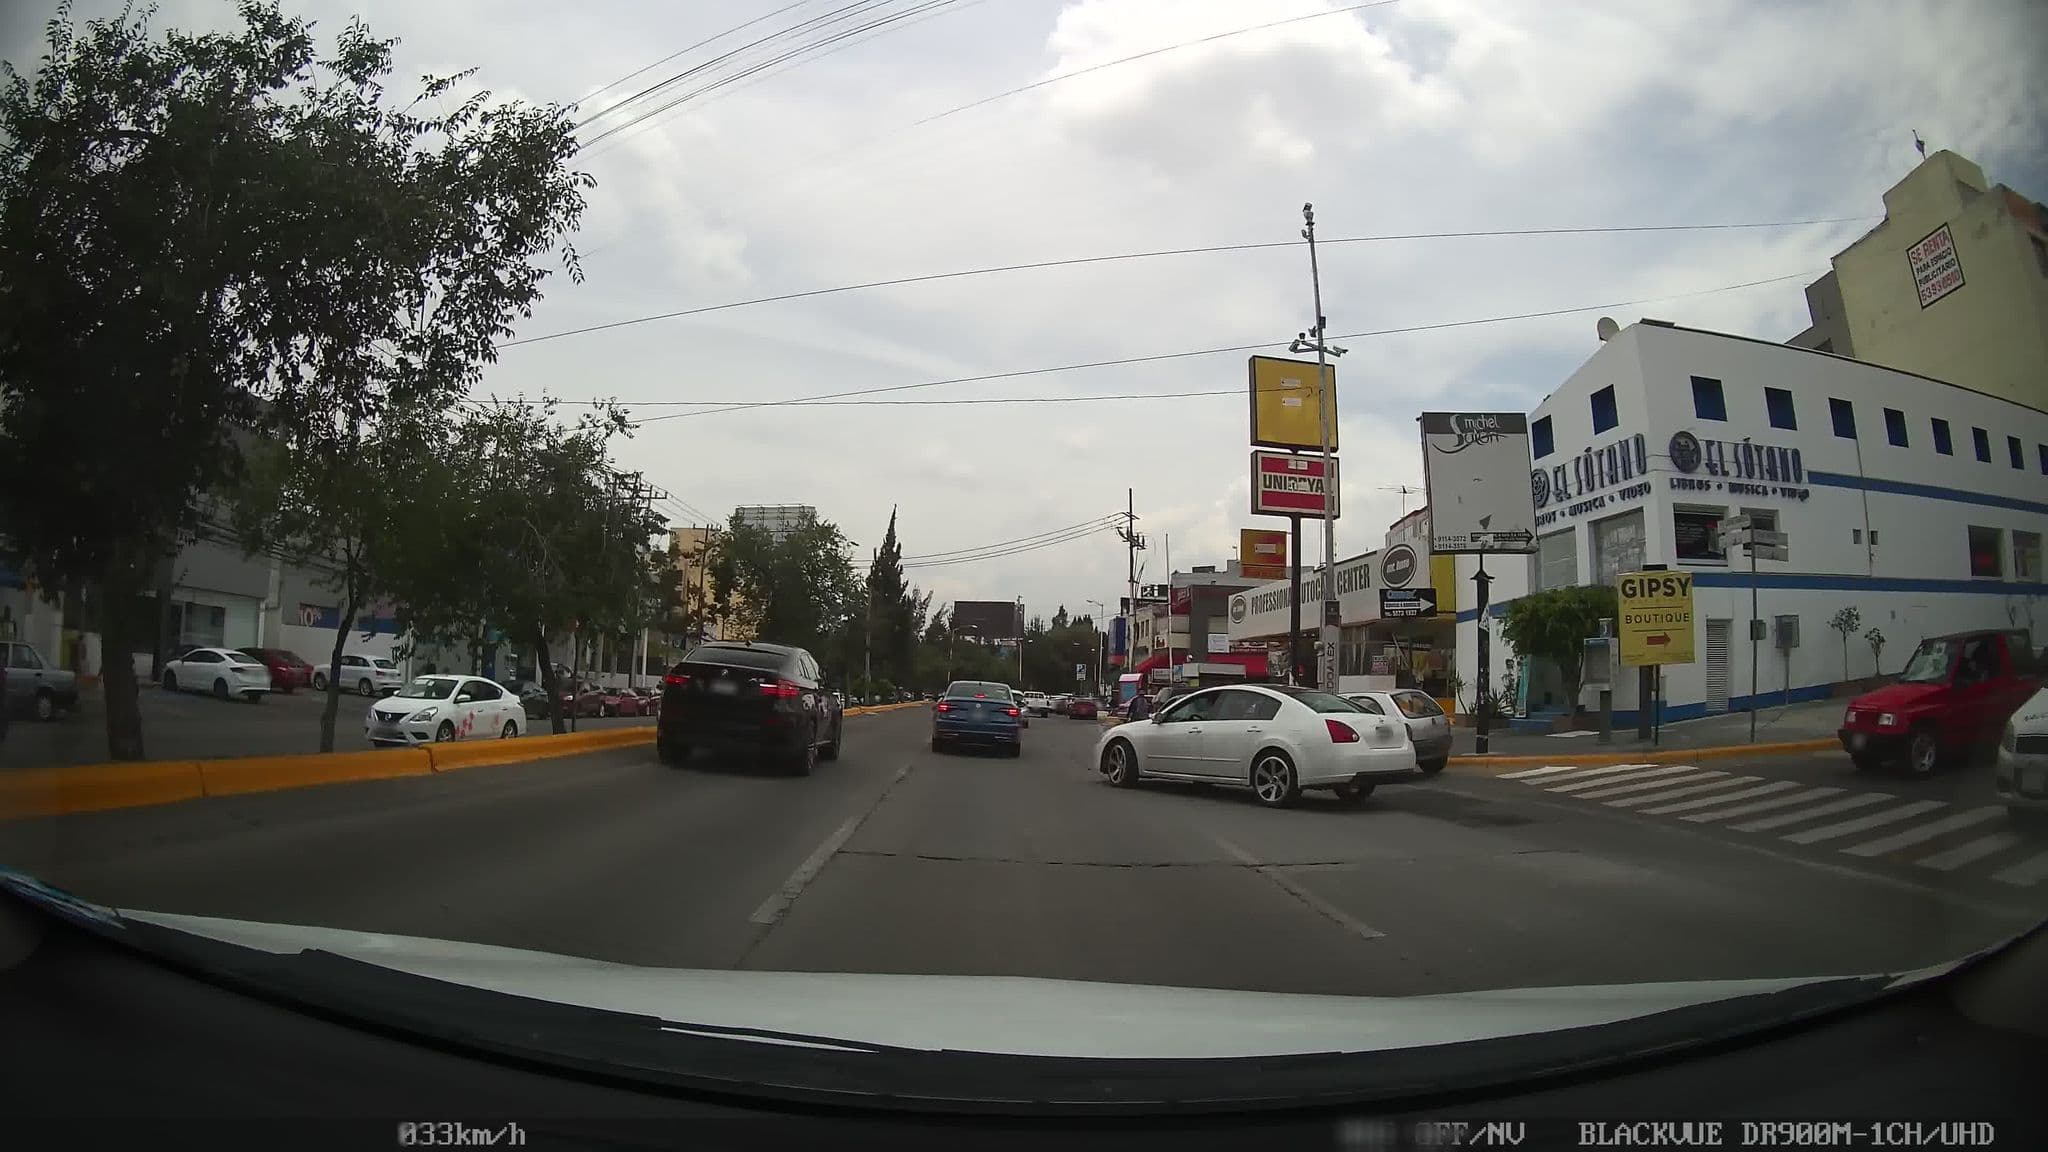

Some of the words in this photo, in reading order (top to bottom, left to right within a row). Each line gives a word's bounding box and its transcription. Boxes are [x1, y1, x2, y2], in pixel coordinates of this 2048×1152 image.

[1910, 247, 1923, 265] SE
[1923, 229, 1951, 258] RENTA
[1553, 464, 1571, 502] EL
[1574, 433, 1647, 496] SÓTANO
[1705, 440, 1729, 476] EL
[1734, 437, 1803, 483] SÓTANO
[1669, 477, 1711, 491] LIBROS
[1251, 586, 1291, 615] PROFESSIONA
[1337, 564, 1370, 595] CENTER
[1621, 577, 1691, 599] GIPSY
[1625, 612, 1690, 624] BOUTIQUE
